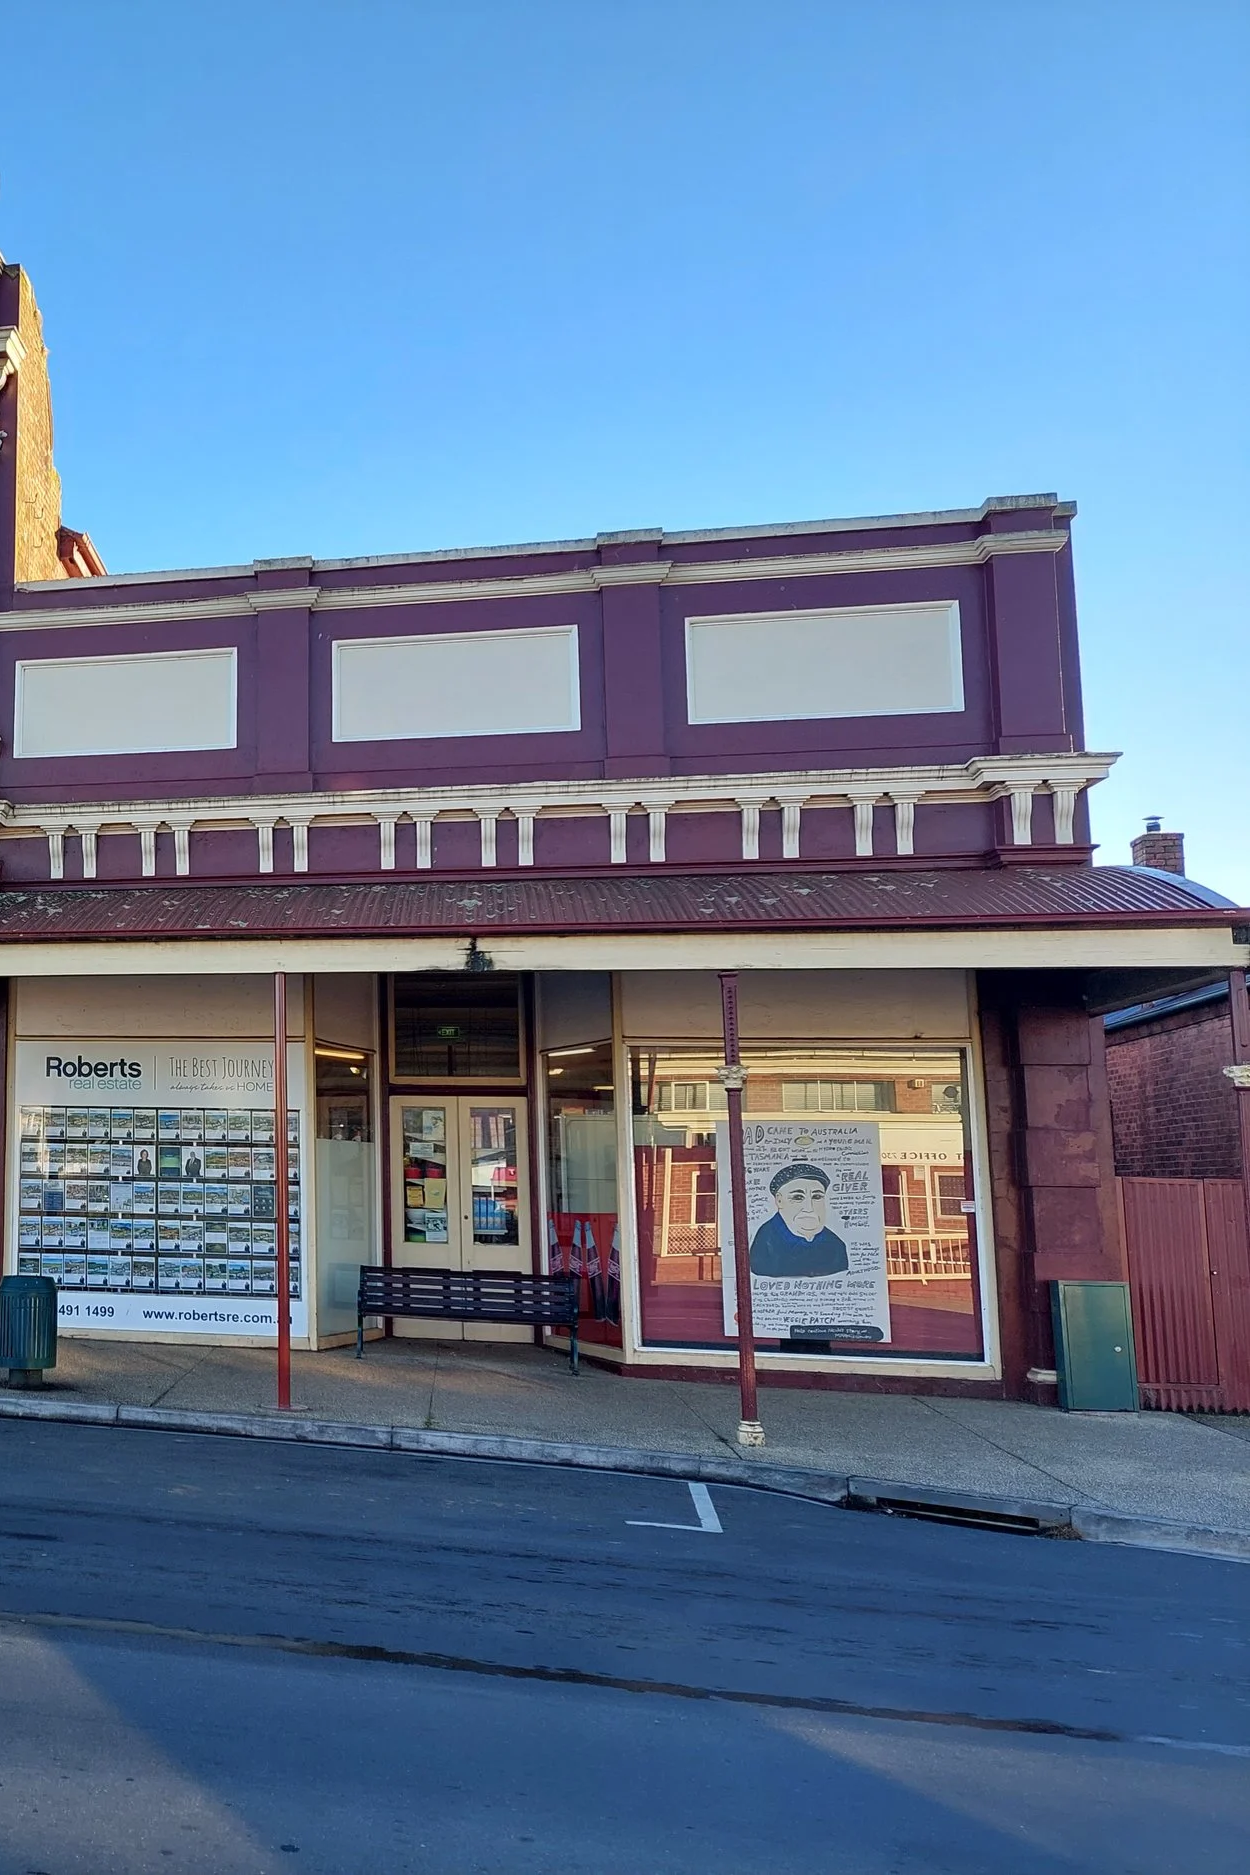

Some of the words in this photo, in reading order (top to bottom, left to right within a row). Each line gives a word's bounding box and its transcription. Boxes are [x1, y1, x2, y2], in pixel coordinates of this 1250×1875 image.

[45, 1055, 142, 1078] Roberts
[169, 1056, 188, 1079] THE
[192, 1057, 217, 1079] BEST
[222, 1056, 274, 1079] JOURNEY
[69, 1077, 94, 1090] real
[97, 1079, 142, 1091] estate
[170, 1081, 199, 1094] always
[200, 1082, 223, 1092] takes
[237, 1081, 274, 1093] HOME
[742, 1124, 765, 1145] AD
[798, 1127, 809, 1135] TO
[810, 1127, 858, 1137] AUSTRALIA
[841, 1170, 870, 1182] REAL
[832, 1181, 868, 1193] GIVER
[753, 1278, 791, 1291] LOVED
[794, 1279, 843, 1290] NOTHING
[58, 1304, 80, 1316] 491
[85, 1304, 116, 1318] 1499
[142, 1309, 293, 1325] www.robertsre.com.
[783, 1316, 808, 1325] VEGGIE
[809, 1316, 836, 1325] PATCH
